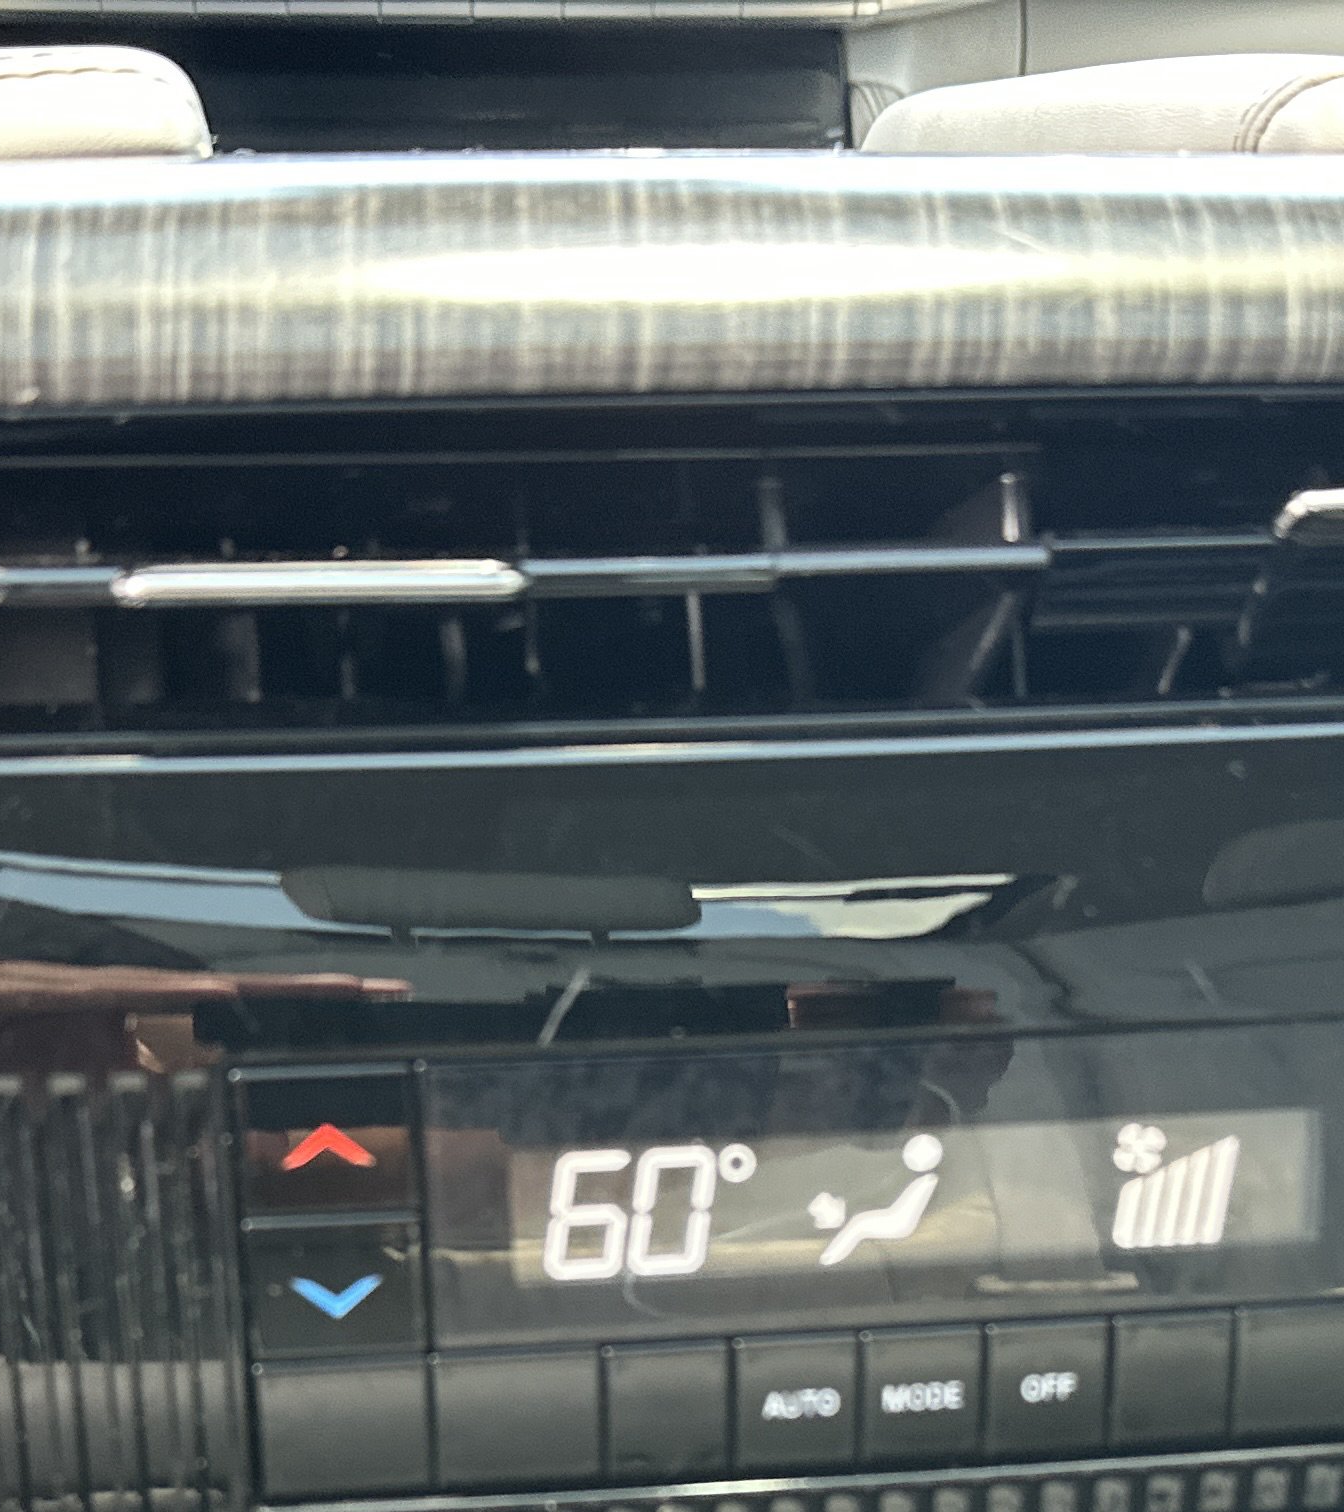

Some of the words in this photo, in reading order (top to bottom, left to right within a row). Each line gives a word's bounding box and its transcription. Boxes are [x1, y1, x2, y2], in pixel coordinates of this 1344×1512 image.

[544, 1143, 757, 1280] 60°
[762, 1387, 841, 1420] AUTO
[881, 1380, 964, 1413] MODE
[1020, 1371, 1078, 1403] OFF
